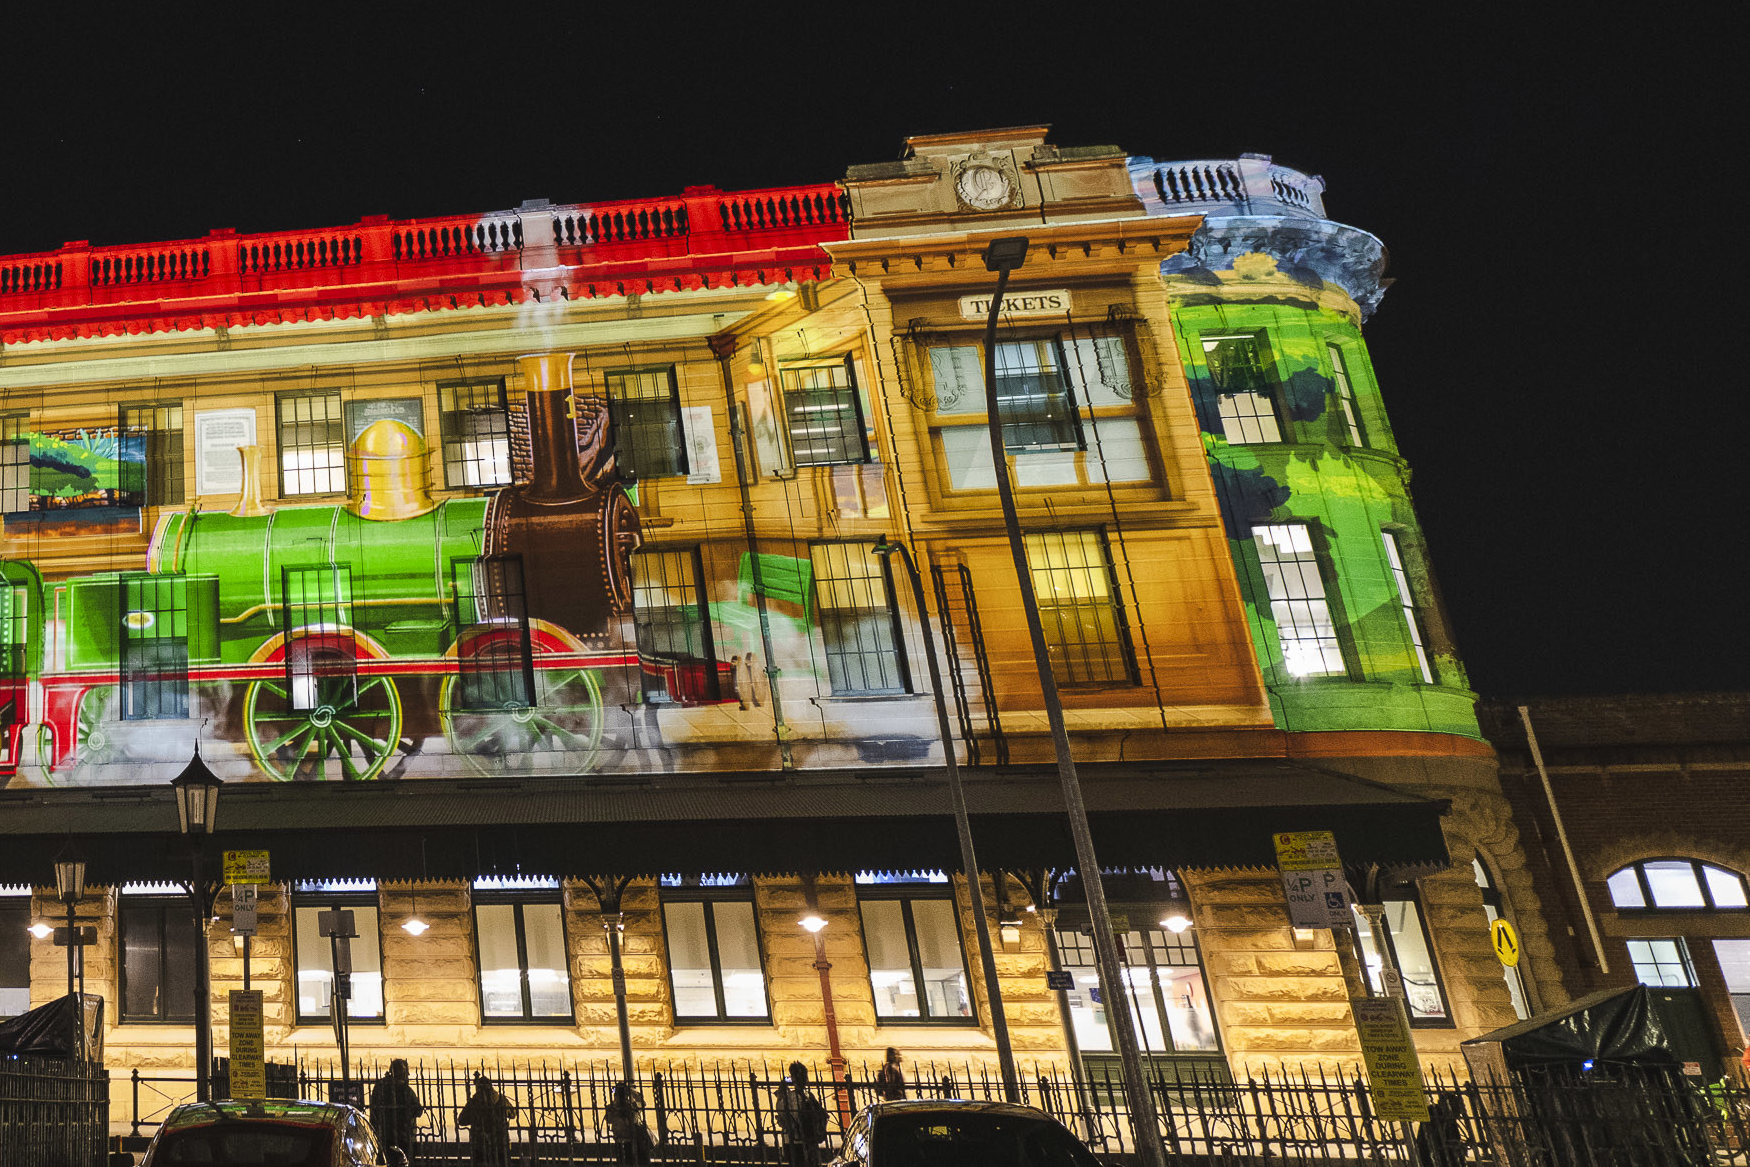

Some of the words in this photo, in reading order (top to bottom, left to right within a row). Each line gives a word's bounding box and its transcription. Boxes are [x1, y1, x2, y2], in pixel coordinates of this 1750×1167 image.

[1323, 874, 1335, 888] P
[1290, 894, 1315, 903] ONLY
[234, 904, 255, 912] ONLY
[1364, 1045, 1383, 1053] TOW
[1385, 1045, 1407, 1053] AWAY
[1370, 1070, 1415, 1078] CLEARWAY
